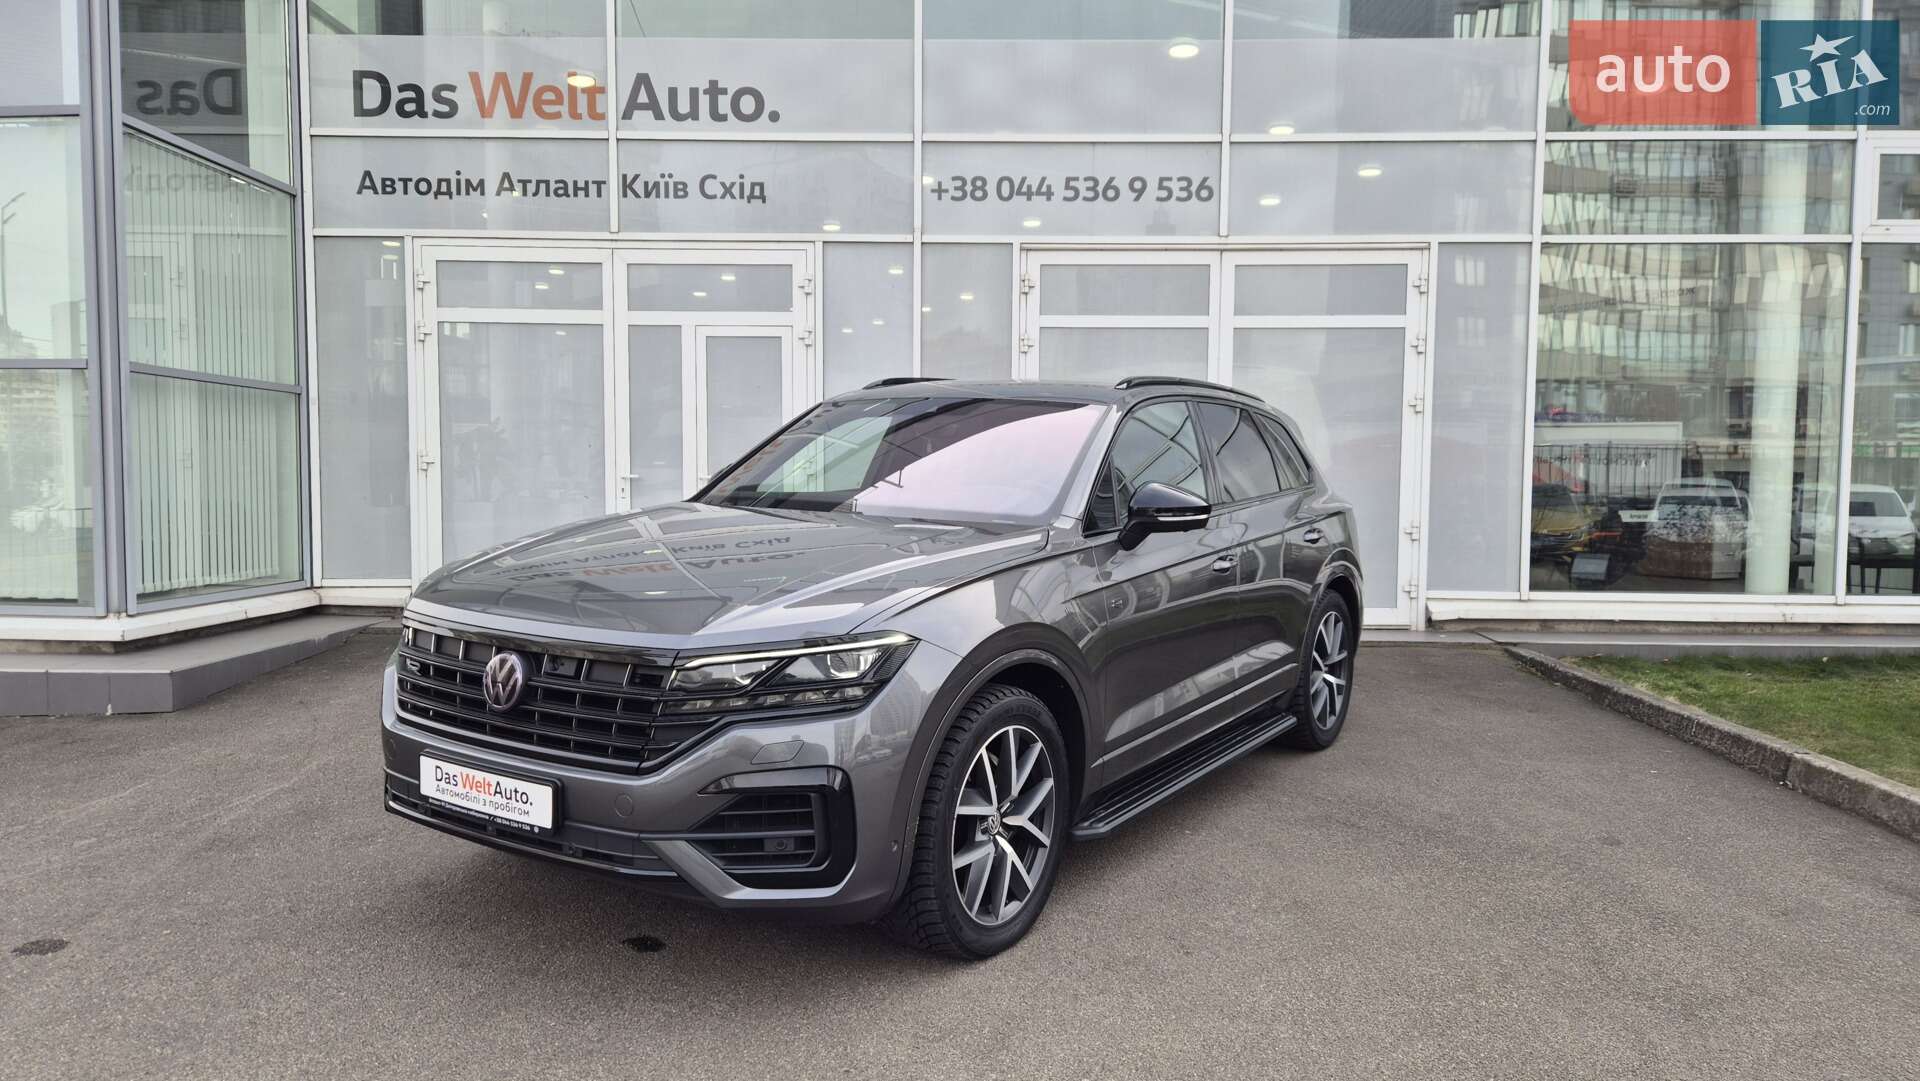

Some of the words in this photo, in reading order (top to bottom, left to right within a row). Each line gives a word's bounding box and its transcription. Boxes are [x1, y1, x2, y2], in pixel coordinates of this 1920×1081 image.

[352, 69, 459, 120] Das
[468, 71, 607, 121] Welt
[621, 72, 781, 123] Auto.
[356, 169, 486, 200] Автодім
[495, 170, 607, 199] Атлант
[622, 172, 689, 200] Київ
[699, 172, 767, 204] Схід
[930, 175, 989, 202] +38
[996, 175, 1055, 202] 044
[1062, 175, 1121, 202] 536
[1128, 175, 1148, 202] 9
[1155, 175, 1215, 202] 536
[435, 765, 458, 787] Das
[460, 771, 493, 796] Welt
[493, 781, 533, 806] Auto.
[435, 784, 480, 804] Автомобілі
[489, 798, 530, 817] пробігом
